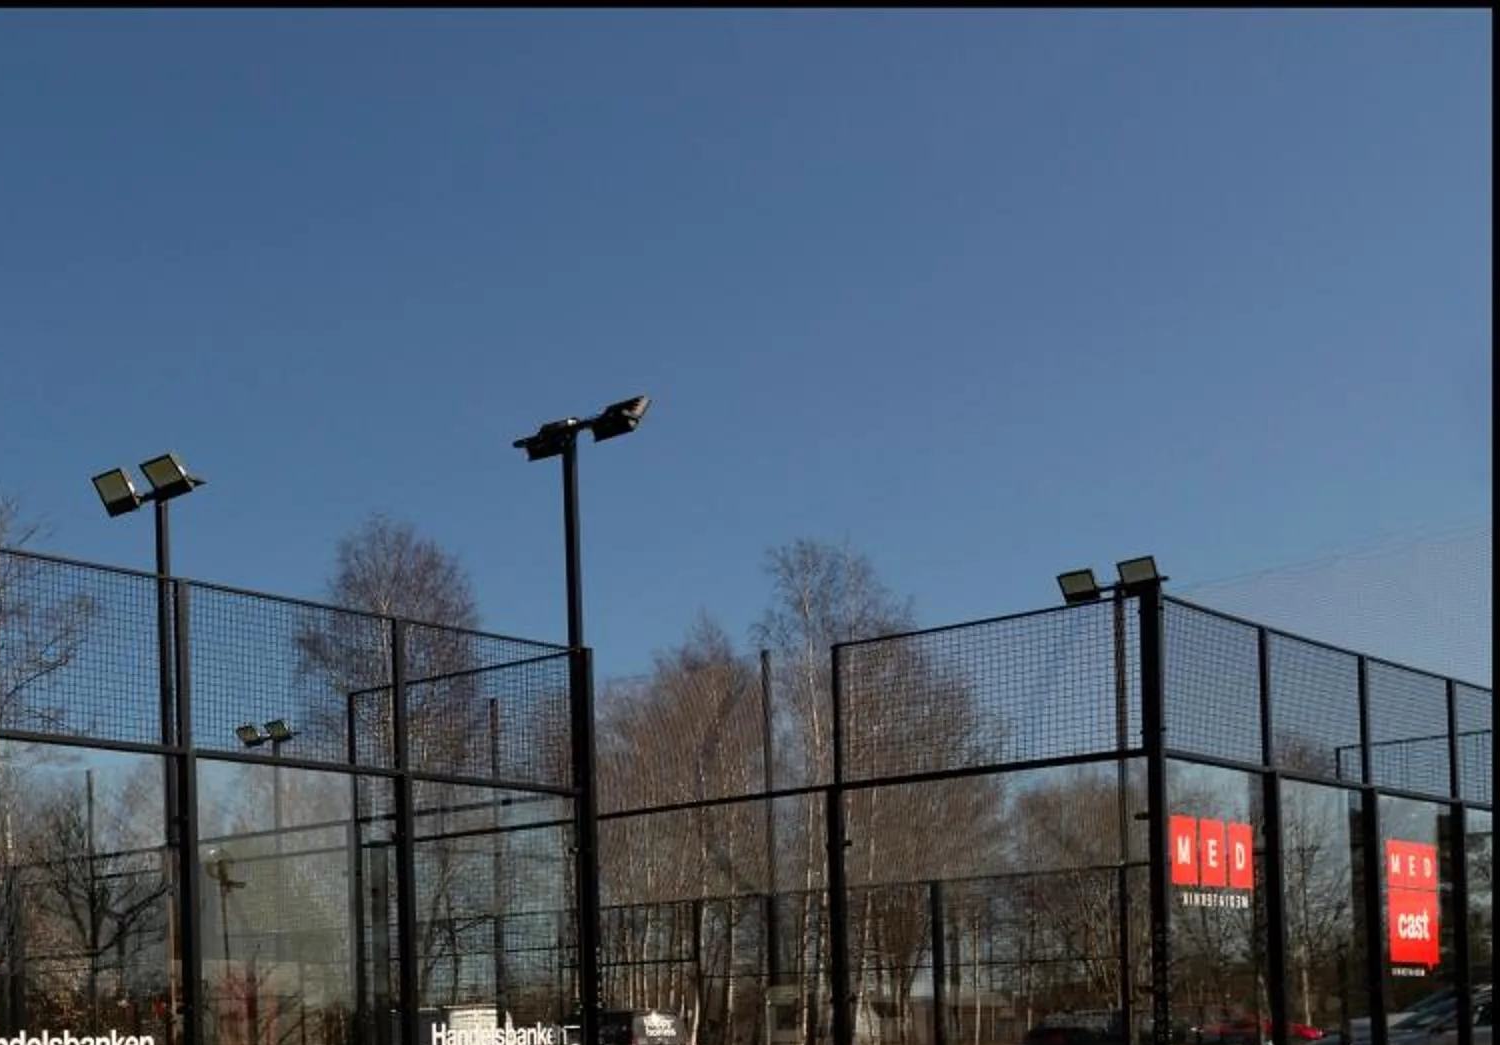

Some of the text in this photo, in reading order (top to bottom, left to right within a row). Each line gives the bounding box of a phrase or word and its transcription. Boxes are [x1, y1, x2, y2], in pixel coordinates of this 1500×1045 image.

[1177, 834, 1245, 871] MED
[1390, 852, 1432, 879] MED
[1397, 908, 1431, 940] cast
